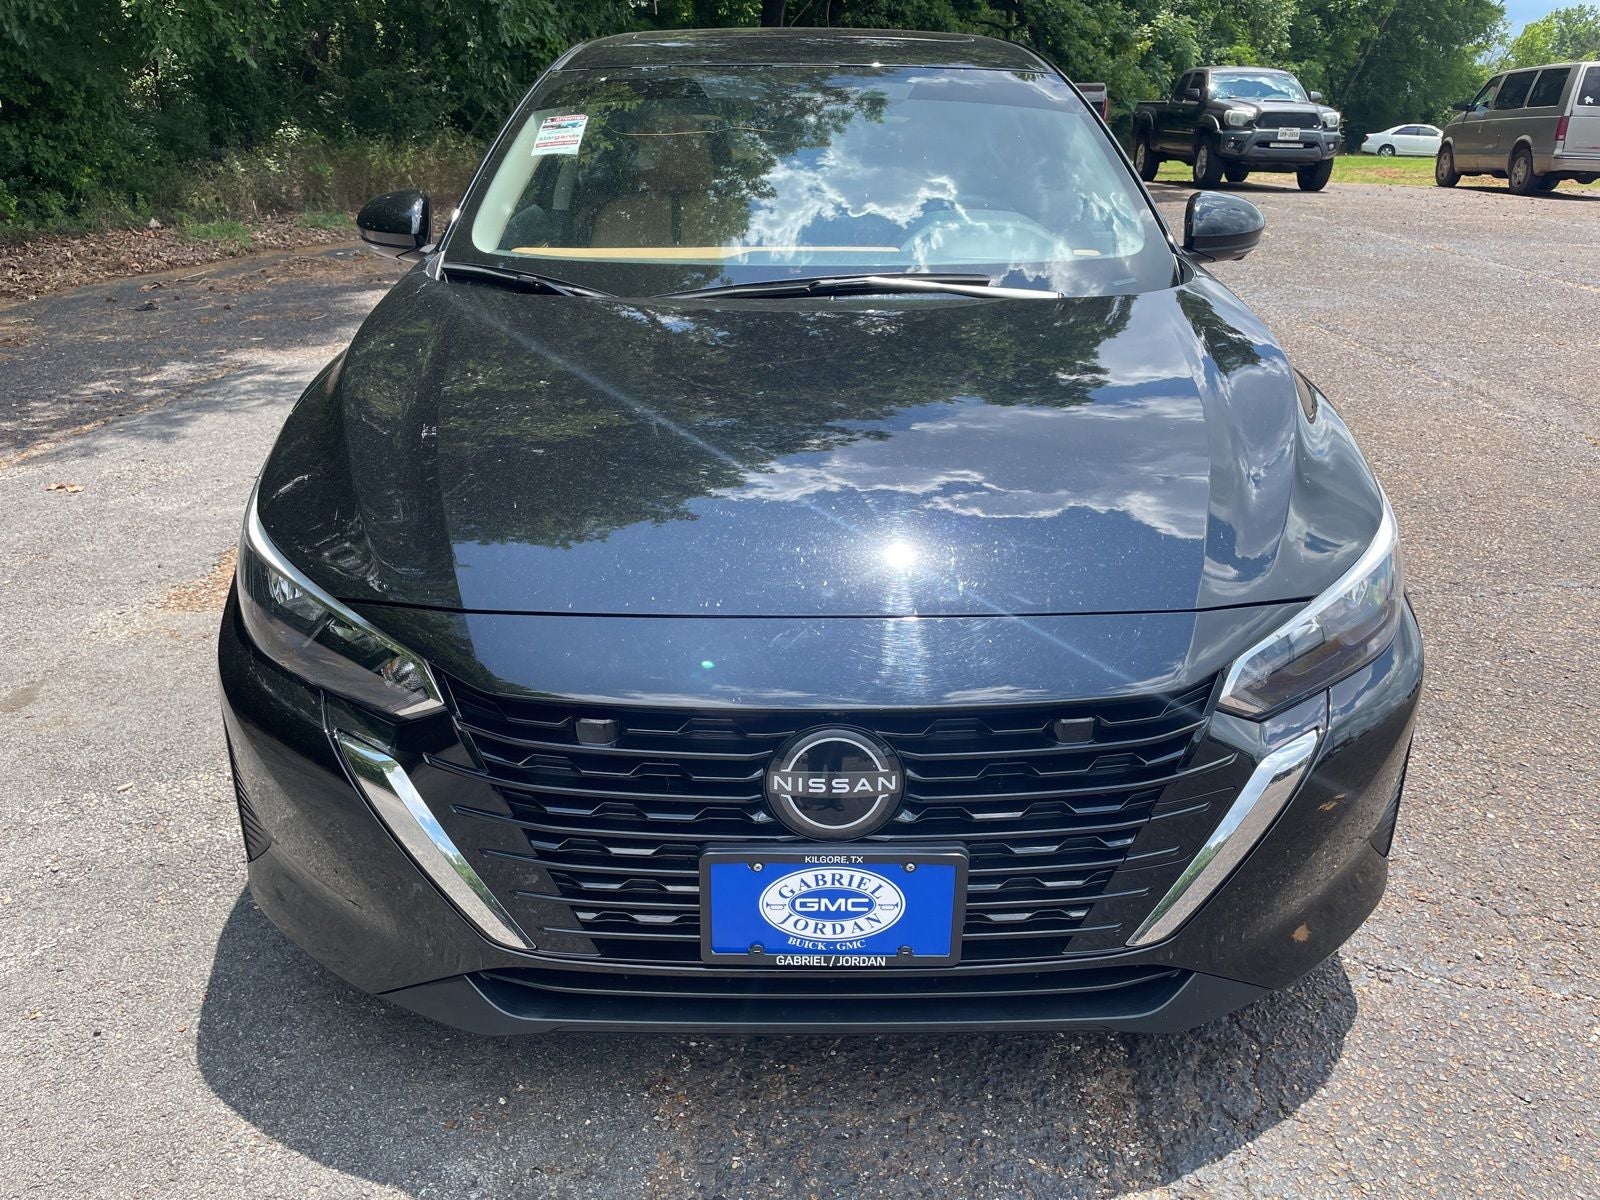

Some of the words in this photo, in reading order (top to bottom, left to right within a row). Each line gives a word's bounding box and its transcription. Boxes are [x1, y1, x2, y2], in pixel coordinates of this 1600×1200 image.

[773, 775, 896, 793] NISSAN
[804, 855, 849, 864] KILGORE,
[850, 855, 864, 864] TX
[778, 873, 884, 899] GABRIEL
[795, 898, 869, 911] GMC
[777, 912, 882, 935] JORDAN
[787, 936, 827, 950] BUICK
[836, 939, 866, 951] GMC
[776, 955, 828, 966] GABRIEL
[836, 956, 886, 966] JORDAN
